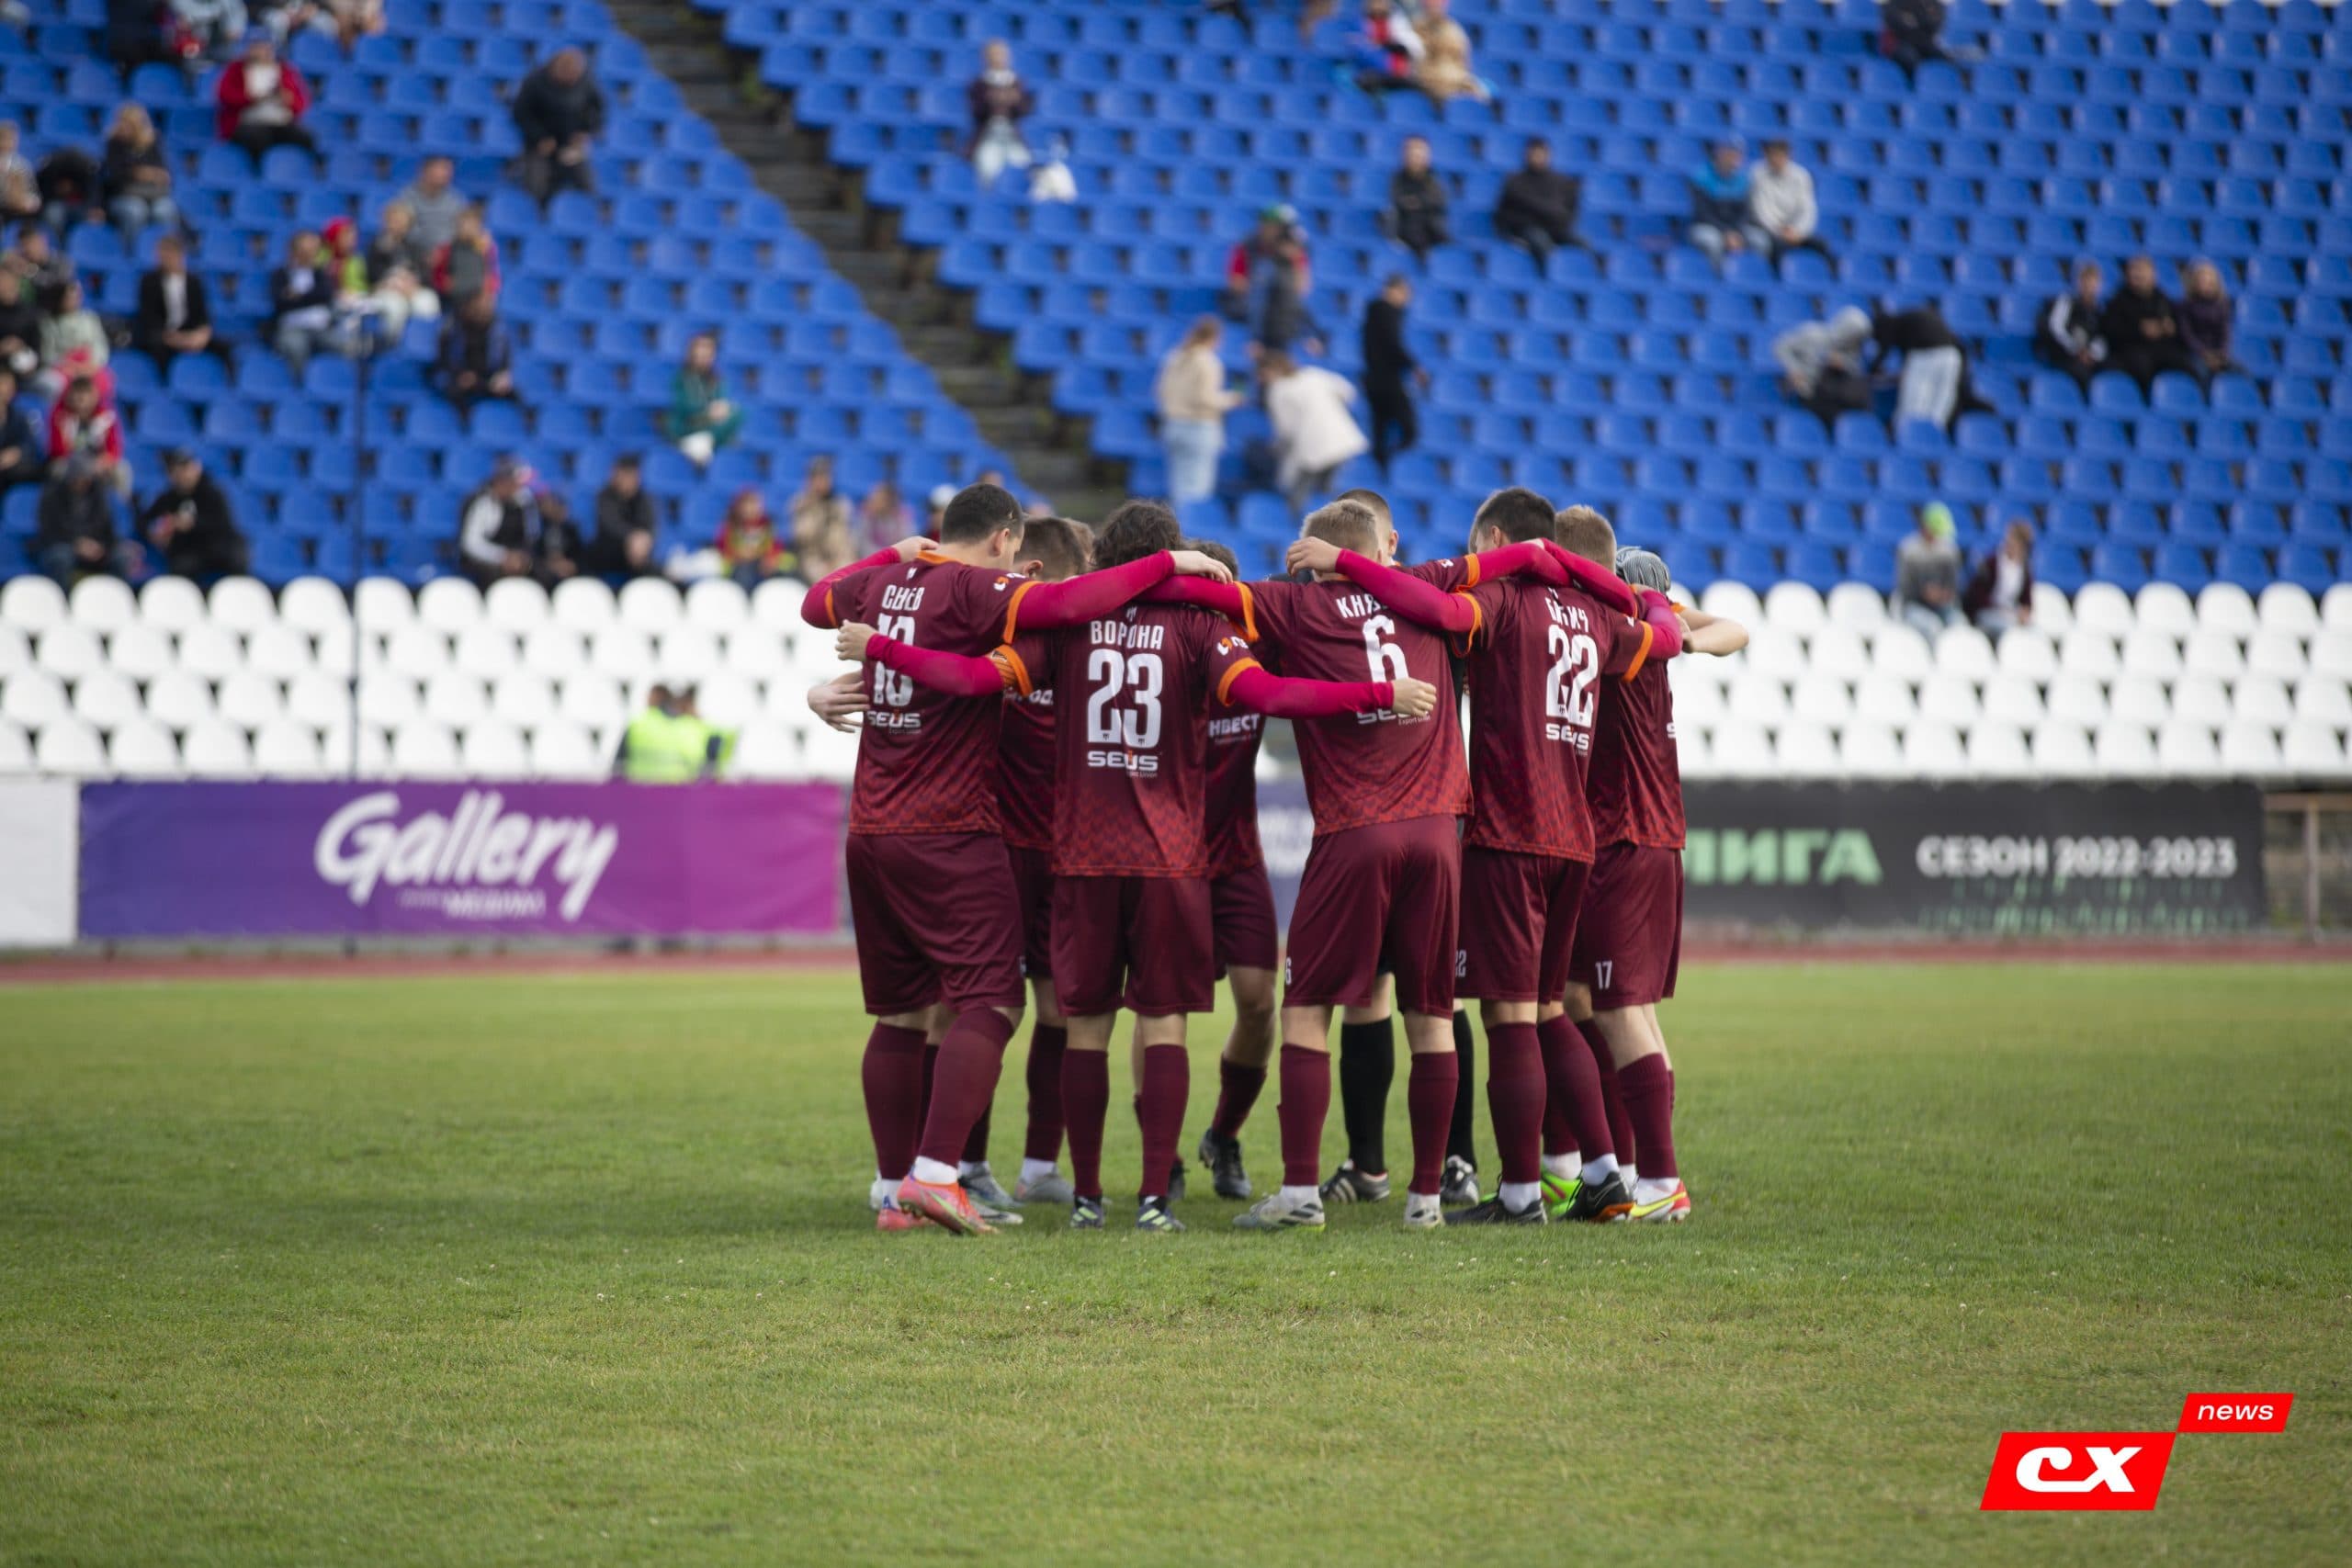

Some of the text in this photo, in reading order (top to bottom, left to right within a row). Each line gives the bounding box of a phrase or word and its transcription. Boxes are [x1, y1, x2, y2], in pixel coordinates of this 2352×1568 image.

[1091, 620, 1165, 650] ВОРОНА
[1363, 615, 1410, 683] 6
[1545, 624, 1599, 728] 22
[866, 710, 922, 728] SEUS
[1087, 648, 1164, 749] 23
[1087, 750, 1159, 772] SEUS
[313, 789, 619, 921] Gallery
[1916, 835, 2049, 877] СЕЗОН
[1594, 960, 1613, 990] 17
